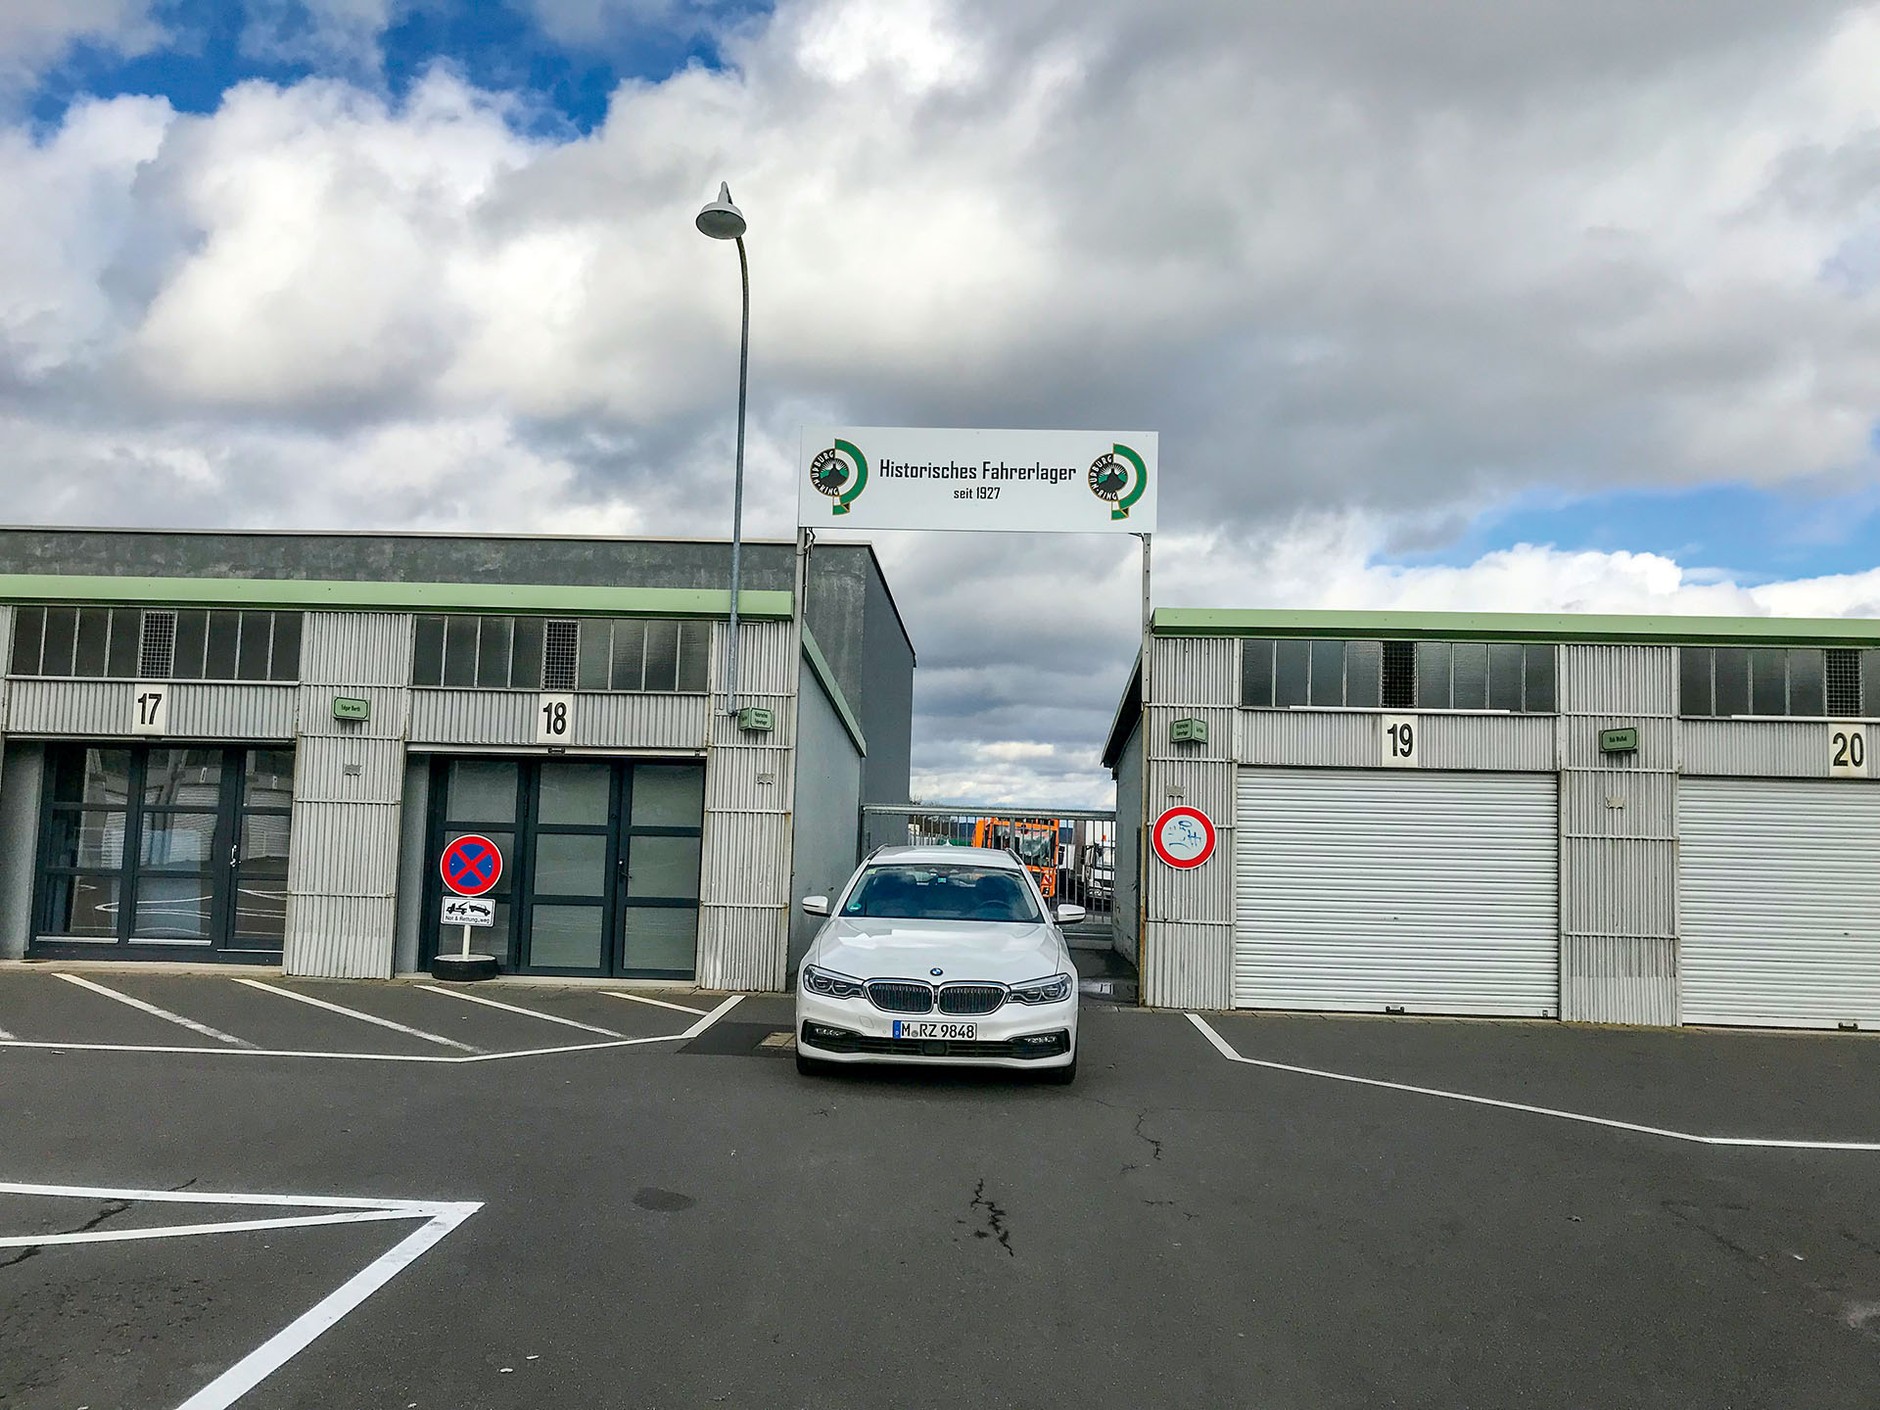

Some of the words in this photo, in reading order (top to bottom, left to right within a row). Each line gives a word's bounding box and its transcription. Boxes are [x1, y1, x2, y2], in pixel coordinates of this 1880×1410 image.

[879, 458, 978, 480] Historisches
[982, 461, 1077, 485] Fahrerlager
[953, 487, 973, 500] seit
[976, 486, 1001, 500] 1927
[137, 693, 163, 725] 17
[542, 702, 567, 735] 18
[1387, 723, 1414, 758] 19
[1832, 732, 1865, 767] 20
[901, 1023, 911, 1037] M
[919, 1023, 938, 1038] RZ
[940, 1024, 975, 1039] 9848
